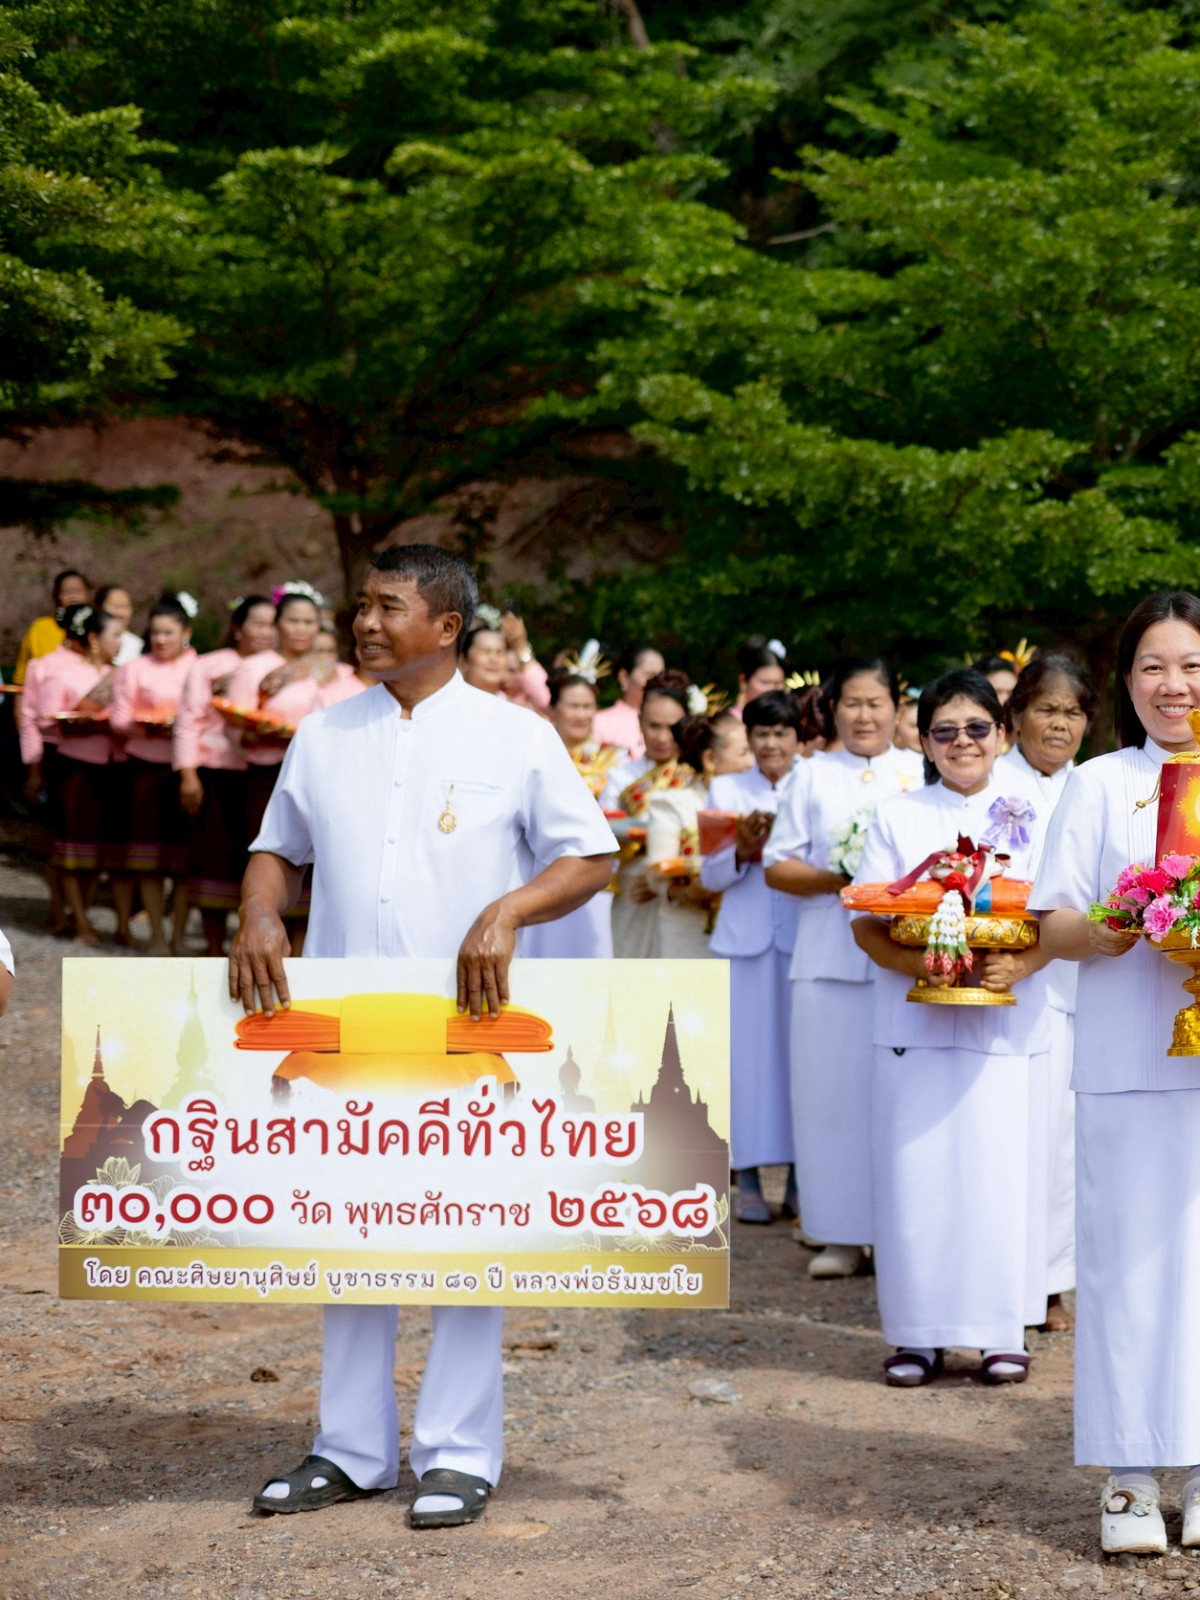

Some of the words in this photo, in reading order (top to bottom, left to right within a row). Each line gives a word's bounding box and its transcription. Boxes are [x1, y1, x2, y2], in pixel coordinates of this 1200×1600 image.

[150, 1084, 636, 1172] กฐินสามัคคีทั่วไทย
[81, 1192, 274, 1233] ๓๐,๐๐๐
[291, 1189, 331, 1225] วัด
[345, 1190, 531, 1239] พุทธศักราช
[548, 1190, 709, 1229] ๒๕๖๘
[86, 1261, 128, 1285] โดย
[138, 1262, 317, 1296] คณะศิษยานุศิษย์
[326, 1269, 434, 1297] บูชาธรรม
[445, 1276, 478, 1290] ๘๑
[488, 1265, 503, 1290] ปี
[513, 1267, 701, 1291] หลวงพ่อธัมมชโย
